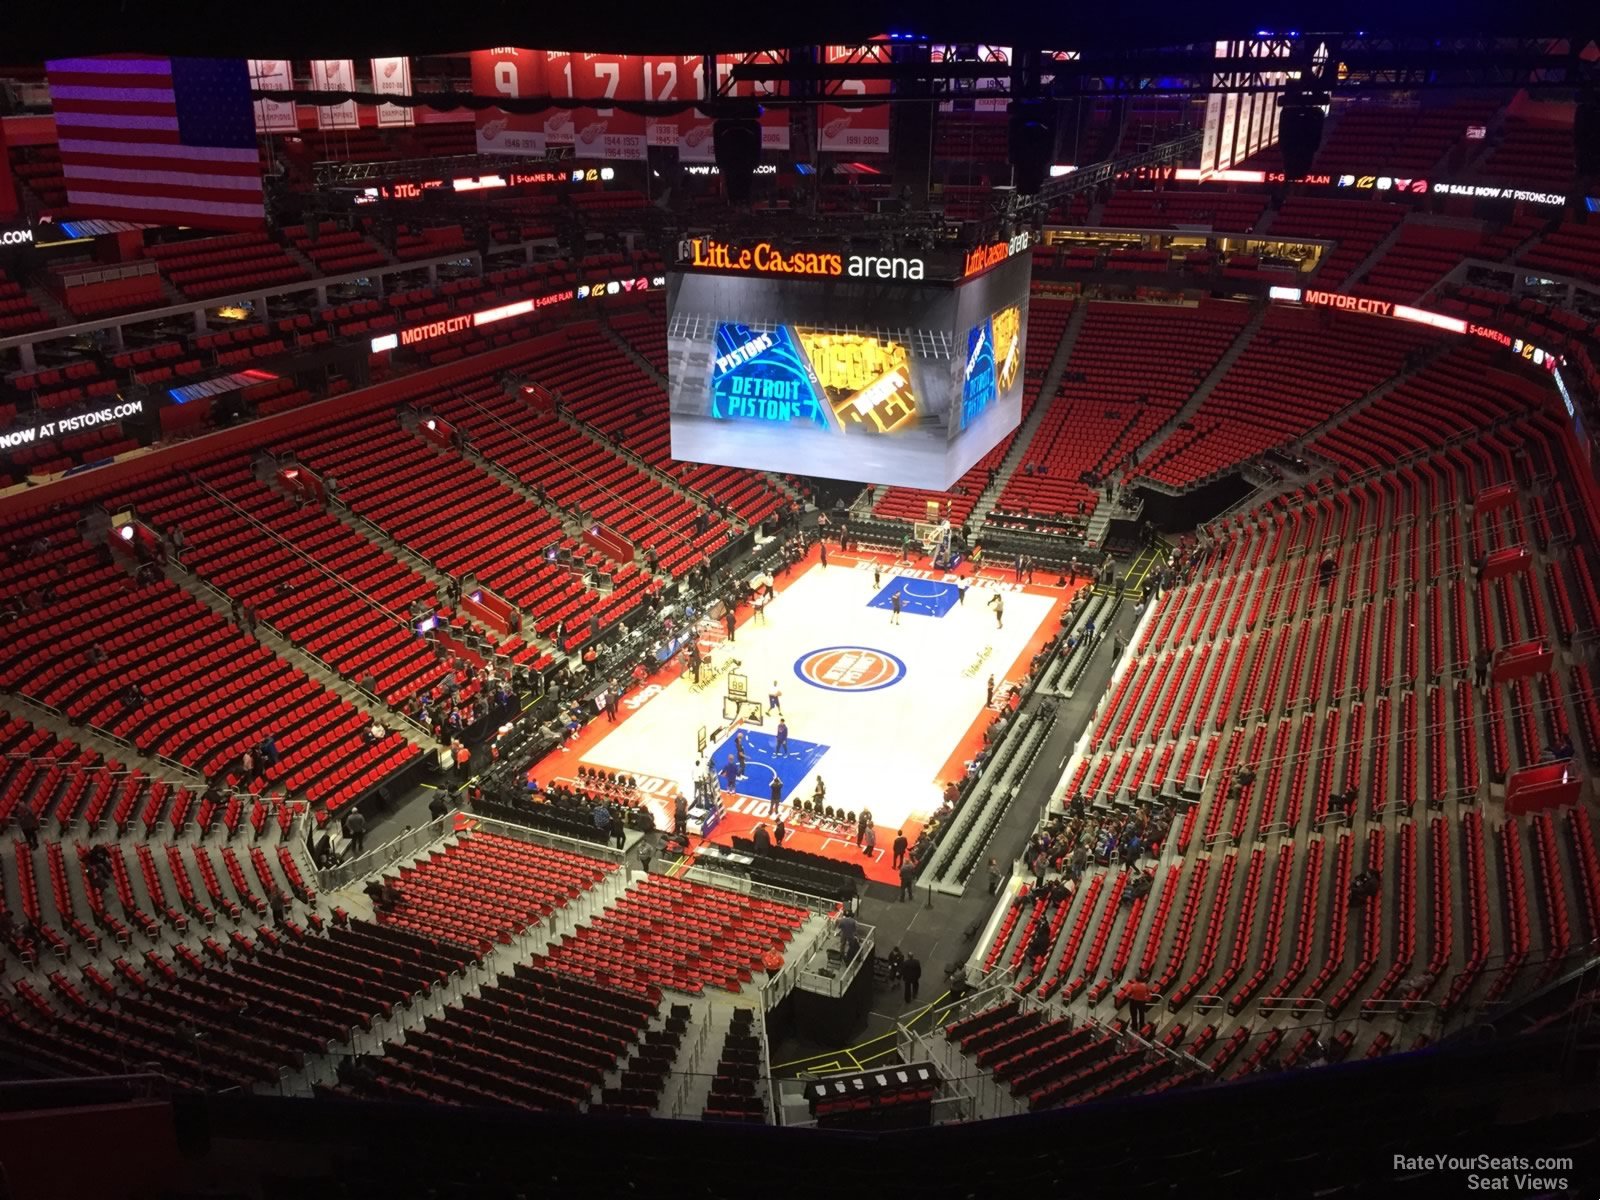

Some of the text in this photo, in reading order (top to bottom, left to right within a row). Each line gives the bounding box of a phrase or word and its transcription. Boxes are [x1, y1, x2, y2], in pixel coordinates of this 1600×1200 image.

[494, 61, 519, 114] 9
[594, 63, 620, 117] 7
[643, 62, 677, 101] 12
[1434, 183, 1566, 206] ON SALE NOW AT PISTONS.COM
[0, 229, 33, 246] .COM
[1008, 231, 1029, 258] arena
[692, 238, 752, 270] Litte
[848, 254, 924, 280] arena
[653, 276, 665, 287] ON
[401, 321, 446, 345] MOTOR
[446, 314, 472, 332] CITY
[536, 295, 558, 308] 5-GAME
[558, 290, 573, 303] PLAN
[1305, 290, 1357, 310] MOTOR
[1357, 298, 1391, 315] CITY
[1469, 324, 1498, 341] 5-GAME
[1497, 331, 1512, 346] PLAN
[715, 331, 773, 375] PISTONS
[731, 375, 801, 399] DETROIT
[0, 400, 143, 450] NOW AT PISTONS.COM
[727, 396, 801, 422] PISTONS
